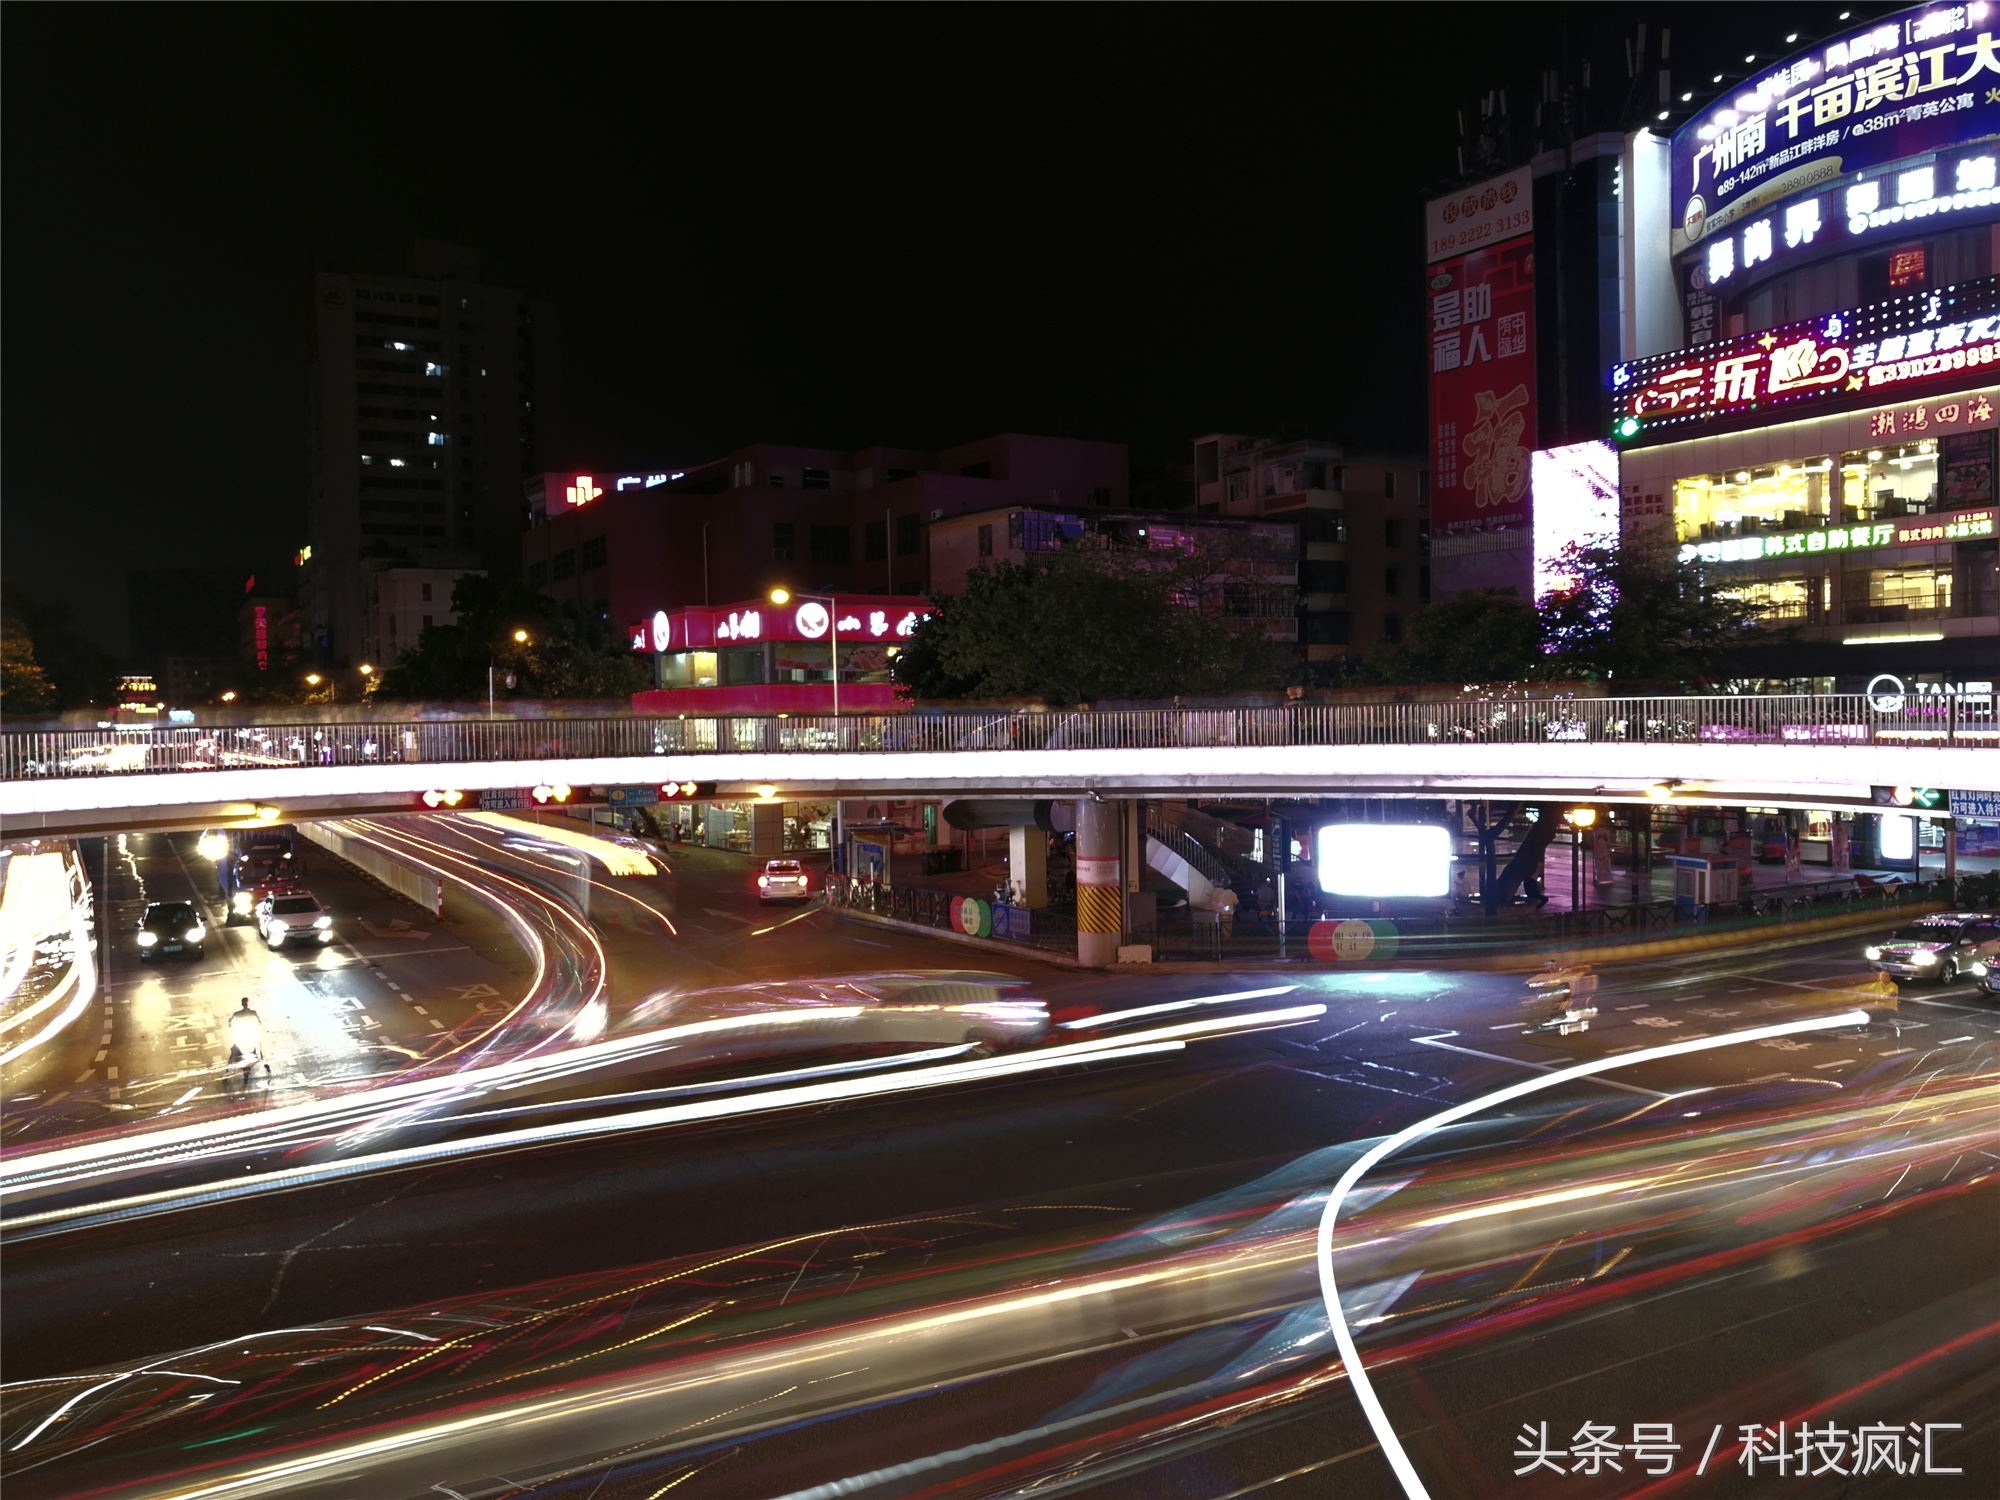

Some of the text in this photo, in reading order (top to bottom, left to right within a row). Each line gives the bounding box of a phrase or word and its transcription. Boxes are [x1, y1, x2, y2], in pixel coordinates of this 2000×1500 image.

[1692, 112, 1766, 193] 广州南
[1776, 33, 2000, 139] 千亩滨江大
[1443, 180, 1518, 224] 投放热线
[1433, 209, 1530, 255] 189 2222 3133
[1870, 393, 1994, 437] 潮鸿四海
[1764, 525, 1895, 556] 韩式自助餐厅
